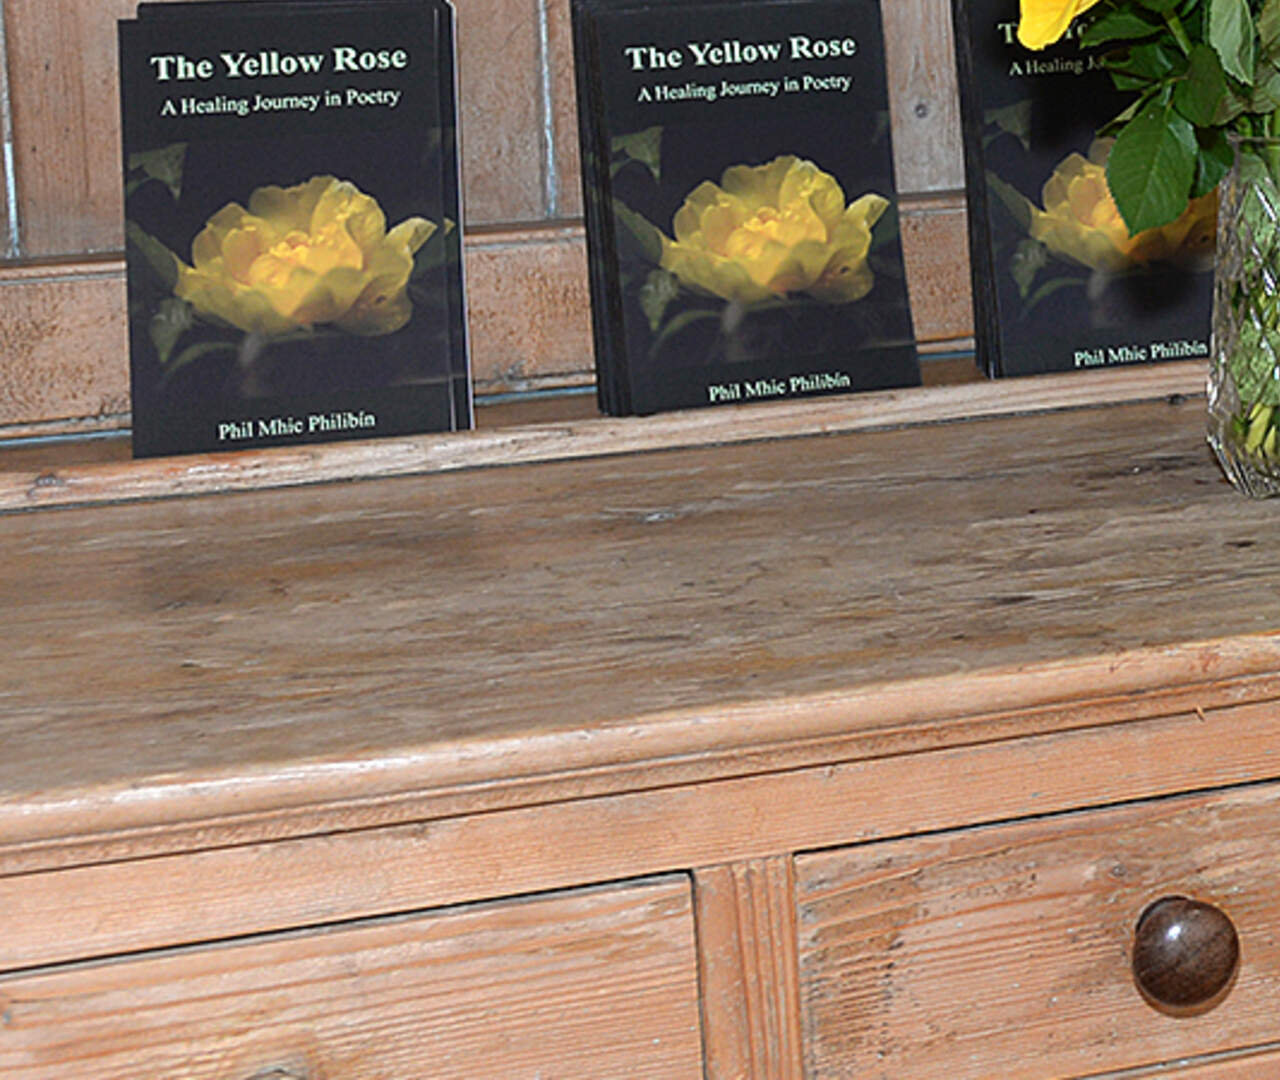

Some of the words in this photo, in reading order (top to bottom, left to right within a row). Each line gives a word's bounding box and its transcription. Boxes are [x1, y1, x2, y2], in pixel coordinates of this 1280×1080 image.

[150, 56, 213, 80] The
[220, 51, 324, 77] Yellow
[333, 47, 407, 71] Rose
[625, 47, 682, 70] The
[688, 40, 781, 65] Yellow
[789, 36, 855, 59] Rose
[1009, 61, 1023, 76] A
[1026, 58, 1084, 75] Healing
[637, 87, 652, 102] A
[654, 83, 717, 101] Healing
[719, 81, 780, 97] Journey
[784, 76, 800, 92] in
[802, 75, 851, 92] Poetry
[161, 100, 177, 116] A
[181, 95, 249, 116] Healing
[253, 95, 320, 112] Journey
[325, 90, 342, 107] in
[346, 88, 401, 107] Poetry
[1074, 349, 1105, 367] Phil
[1108, 345, 1147, 363] Mhic
[708, 383, 741, 402] Phil
[744, 379, 786, 398] Mhic
[218, 421, 253, 440] Phil
[258, 417, 304, 437] Mhic
